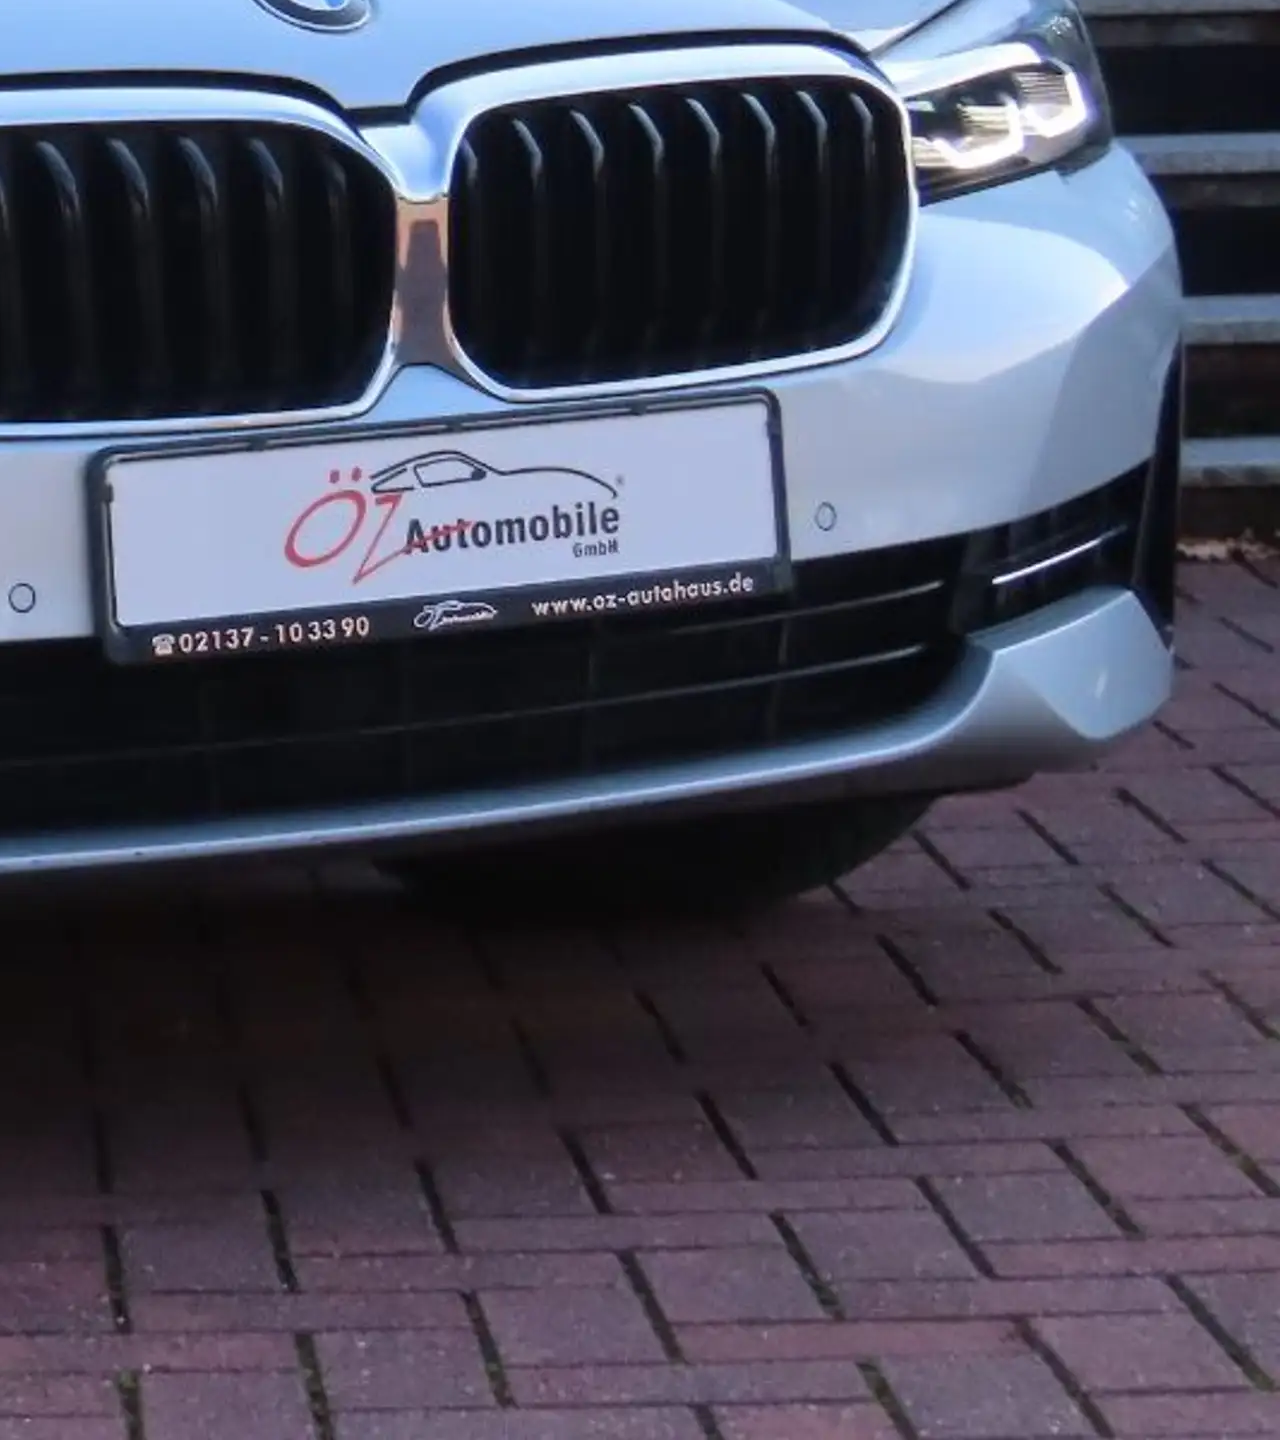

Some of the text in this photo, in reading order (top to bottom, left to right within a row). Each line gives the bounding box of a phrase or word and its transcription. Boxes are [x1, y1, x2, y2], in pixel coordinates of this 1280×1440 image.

[405, 501, 621, 555] Automobile
[572, 538, 620, 558] GmbH
[531, 571, 754, 617] www.oz-autohaus.de
[178, 626, 255, 654] 02137
